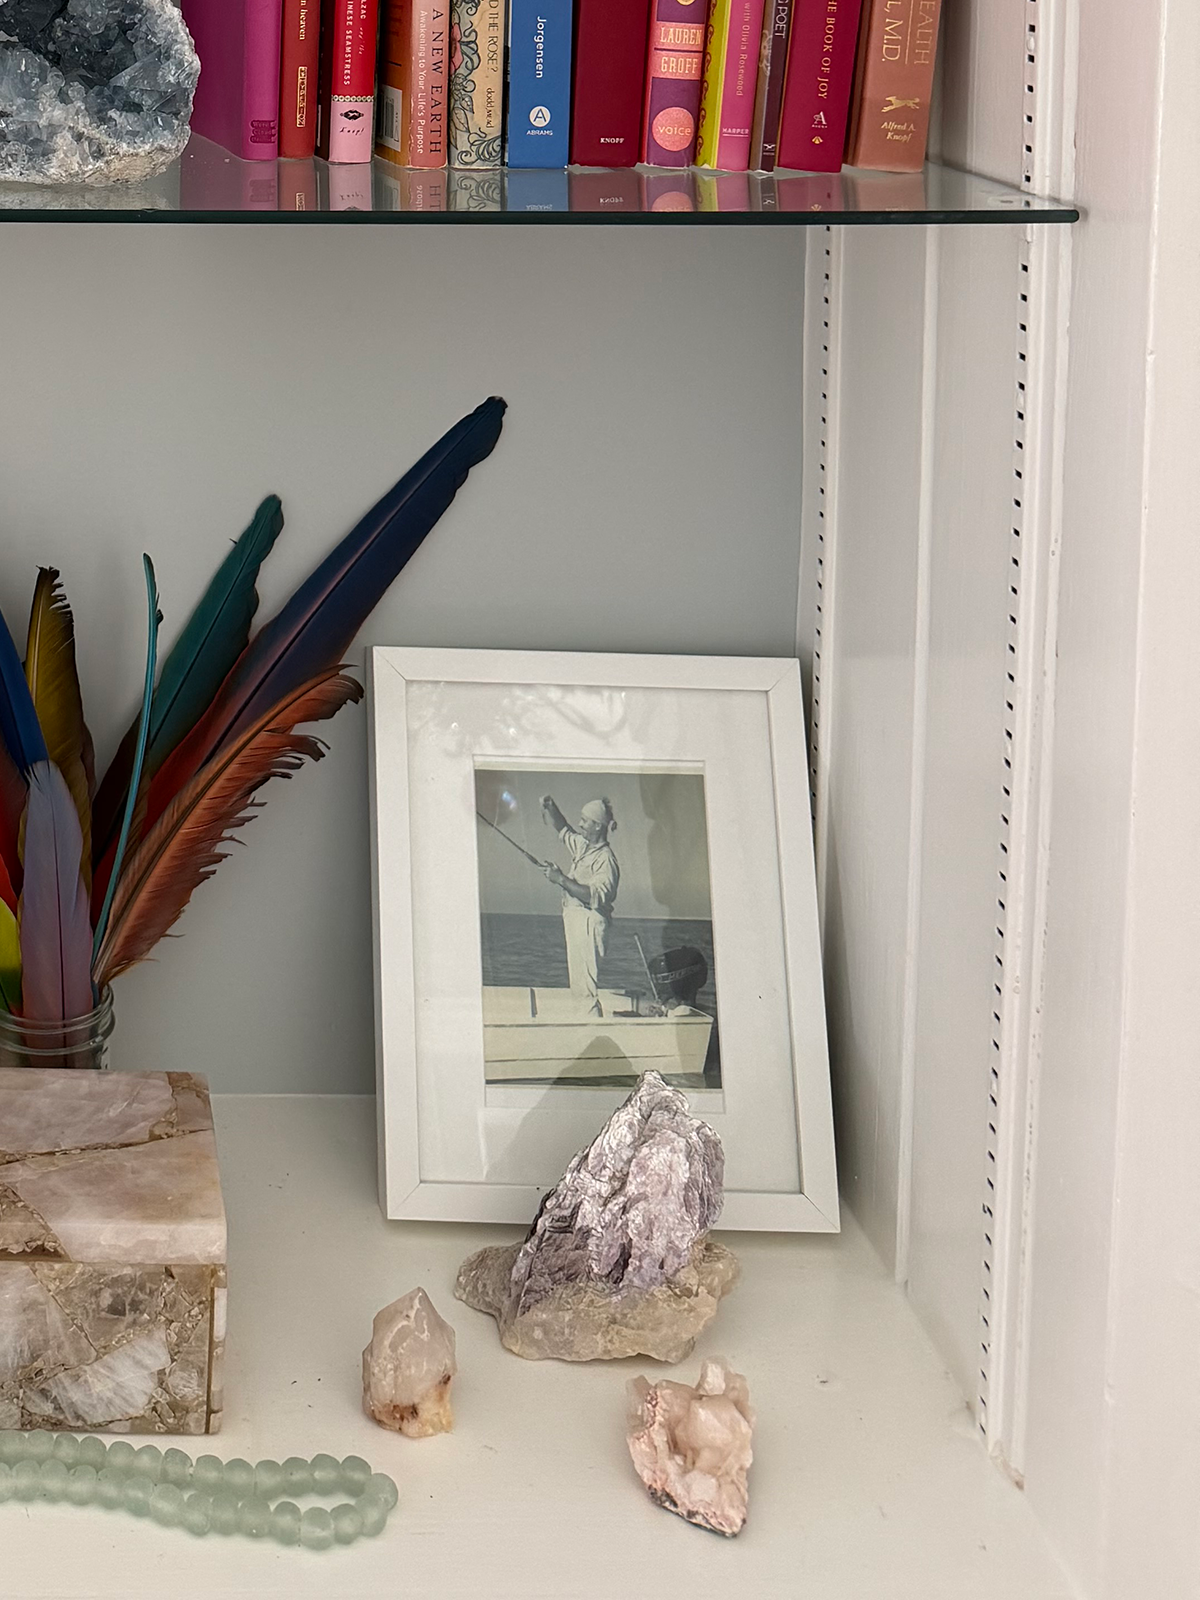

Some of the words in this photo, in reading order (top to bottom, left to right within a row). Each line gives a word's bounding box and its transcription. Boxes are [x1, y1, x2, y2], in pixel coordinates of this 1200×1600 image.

[431, 9, 443, 21] A
[535, 15, 547, 79] Jorgensen
[660, 26, 702, 45] LAUREN
[882, 18, 904, 62] M.D.
[431, 30, 444, 74] NEW
[661, 56, 698, 74] GROFF
[430, 84, 443, 156] EARTH
[658, 123, 691, 136] voice
